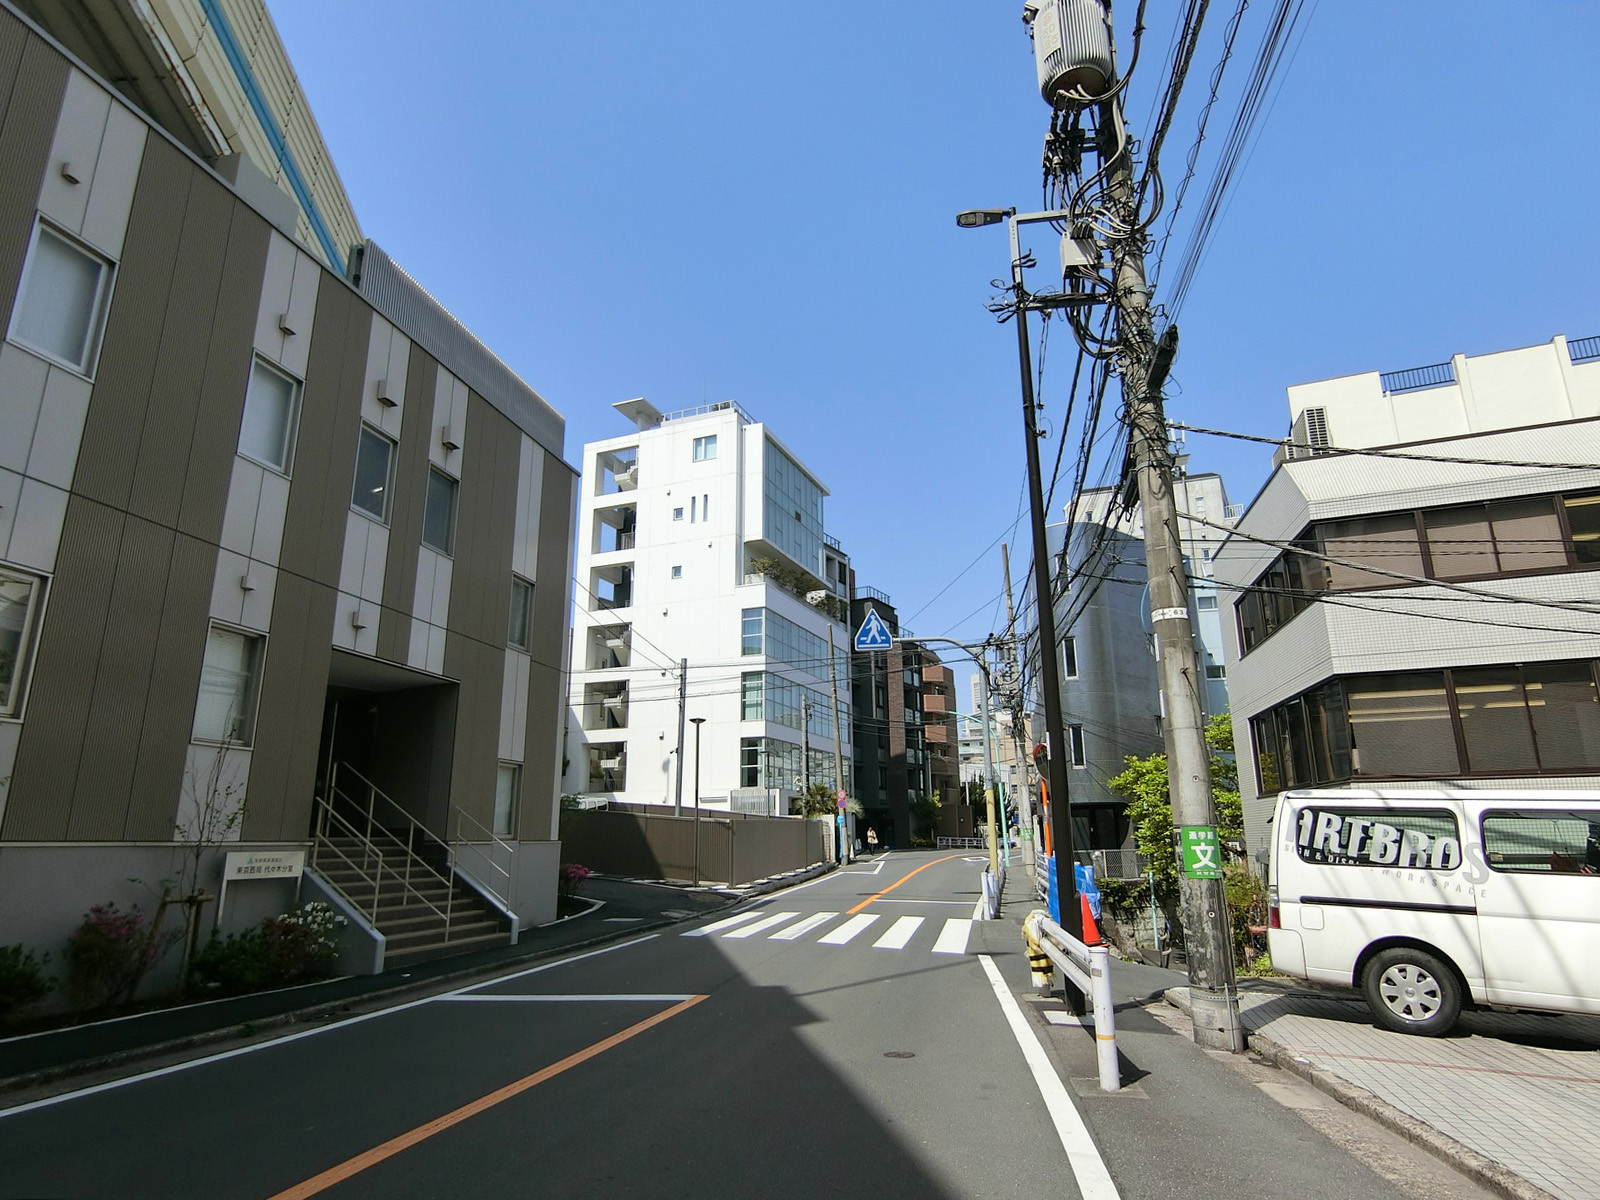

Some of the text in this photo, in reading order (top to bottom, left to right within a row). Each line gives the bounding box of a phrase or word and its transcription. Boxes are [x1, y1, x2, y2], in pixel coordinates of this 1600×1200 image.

[1190, 842, 1217, 869] 文
[1285, 808, 1490, 885] ARTBROS
[1315, 852, 1321, 861] &
[1382, 869, 1487, 899] WORKSPACE
